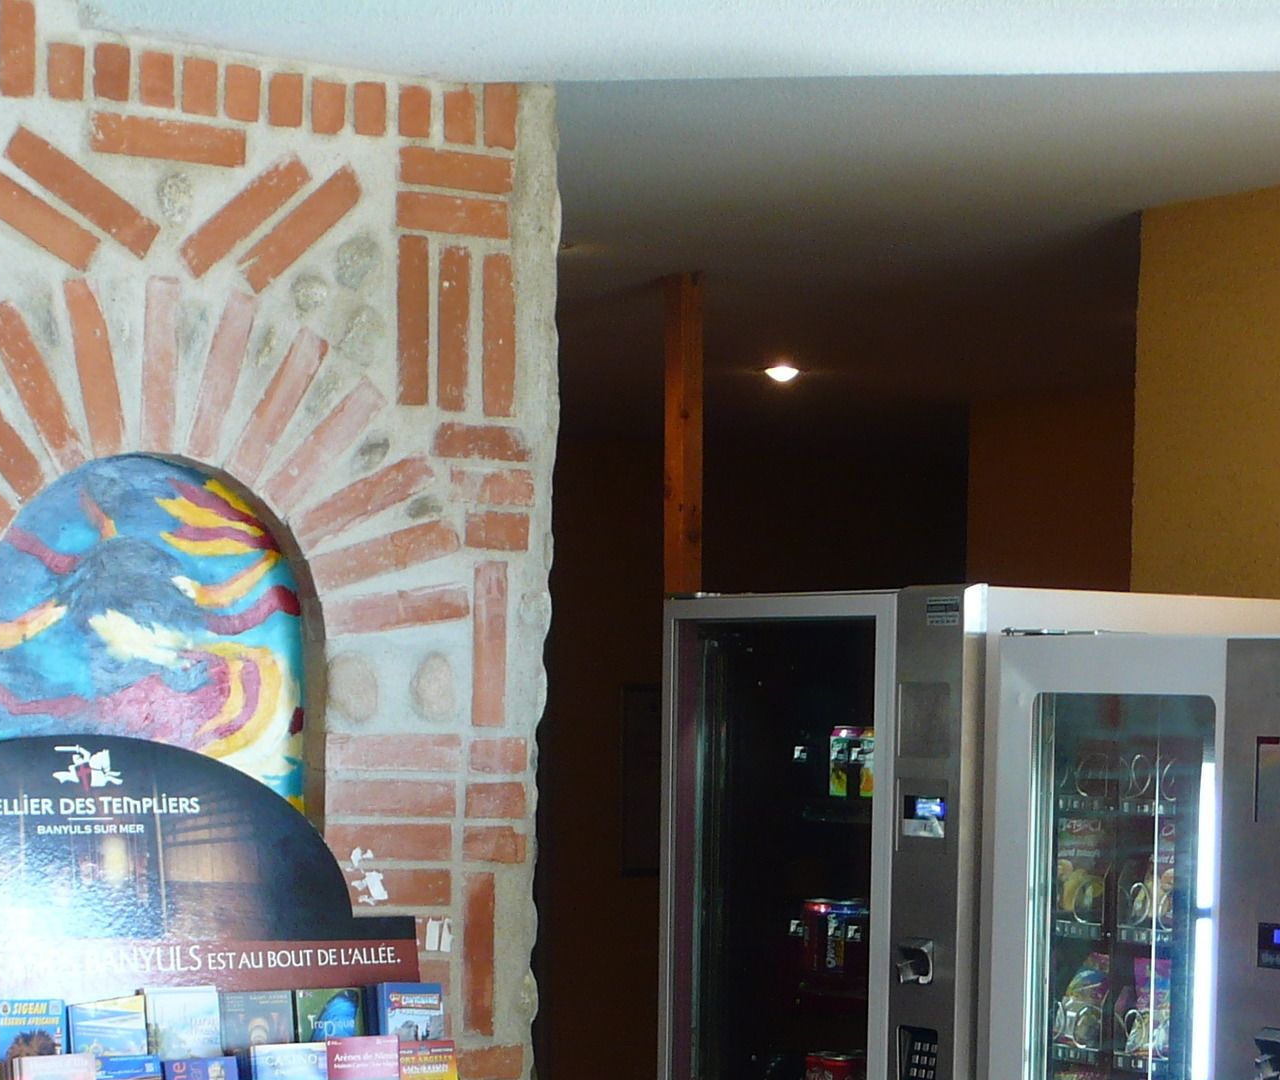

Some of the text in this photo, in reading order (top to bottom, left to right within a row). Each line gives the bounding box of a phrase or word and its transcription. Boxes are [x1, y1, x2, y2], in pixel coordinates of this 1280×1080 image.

[60, 797, 96, 815] DES
[36, 824, 145, 836] BANYULS SUR MER
[207, 950, 237, 971] EST
[238, 950, 264, 970] AU
[267, 949, 313, 969] BOUT
[316, 949, 338, 966] DE
